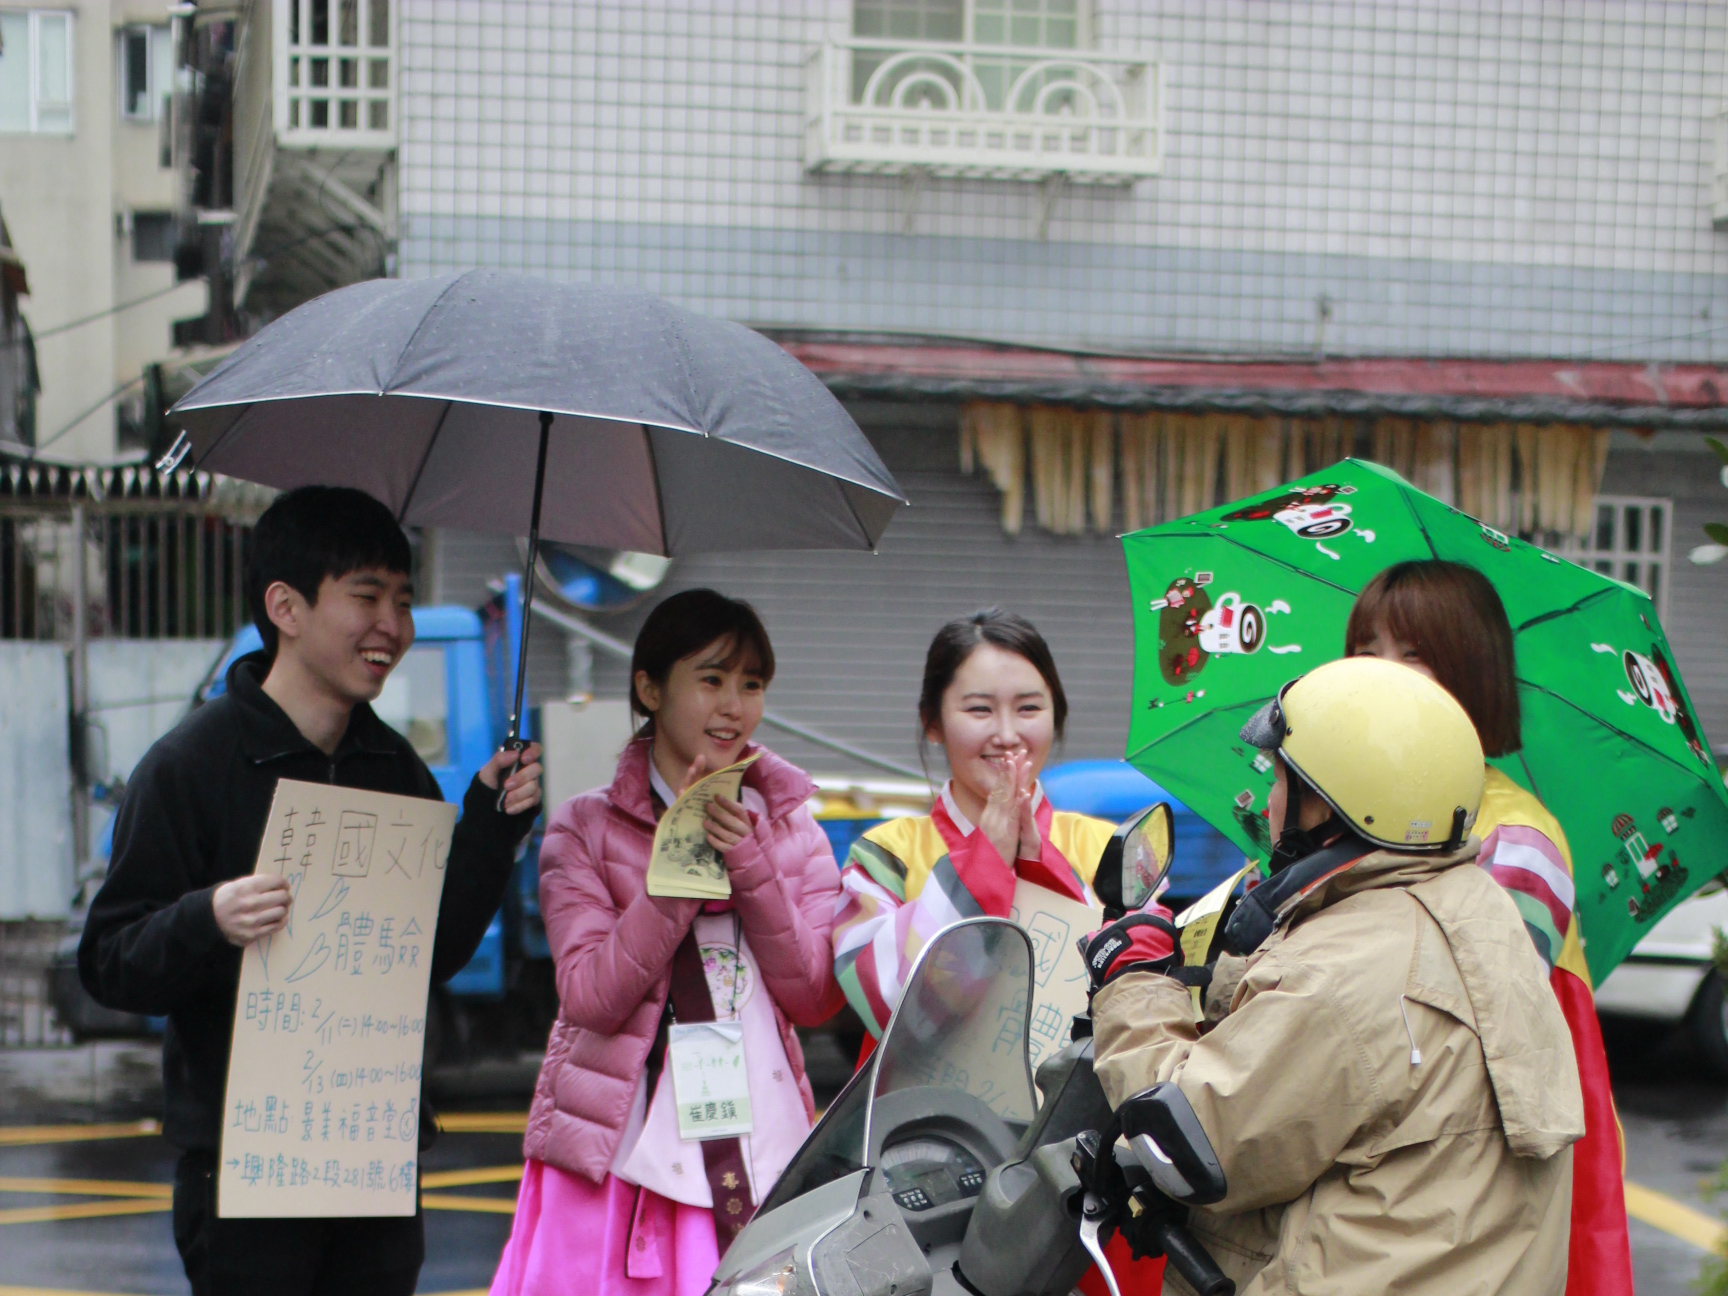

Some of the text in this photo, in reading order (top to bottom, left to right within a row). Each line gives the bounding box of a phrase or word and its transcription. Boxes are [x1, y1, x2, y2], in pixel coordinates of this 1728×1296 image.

[273, 806, 448, 882] 韓國文化
[335, 911, 423, 975] 體驗
